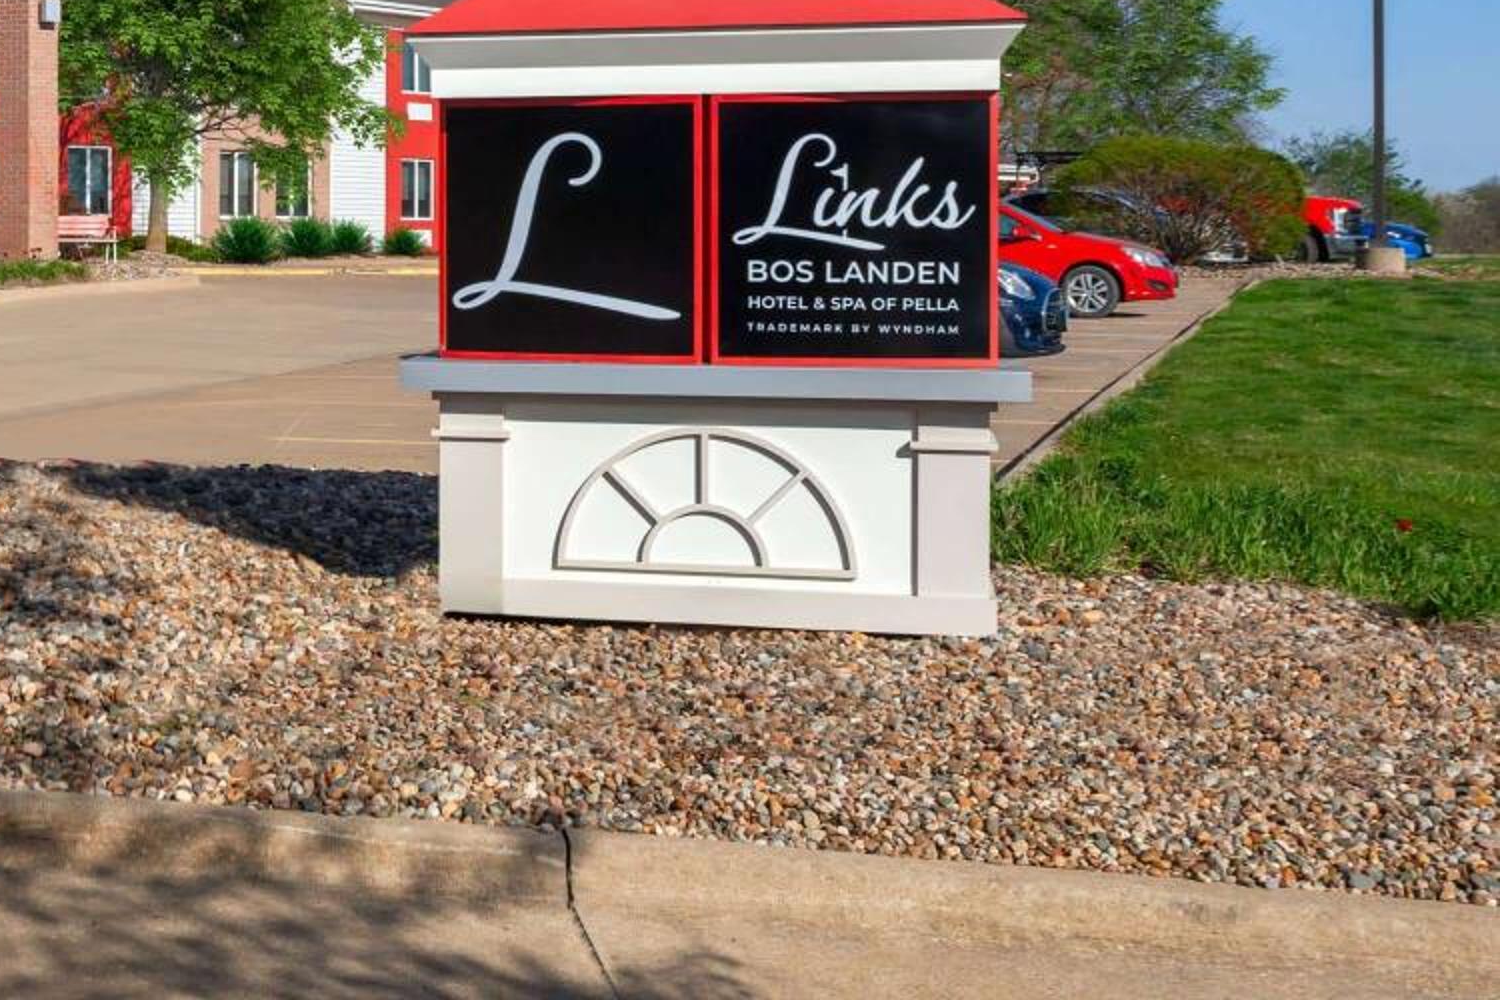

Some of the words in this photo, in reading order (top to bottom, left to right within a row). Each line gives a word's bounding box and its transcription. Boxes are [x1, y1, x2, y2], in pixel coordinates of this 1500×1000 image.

[732, 133, 977, 250] Links
[452, 133, 682, 321] L
[747, 260, 815, 283] BOS
[825, 260, 960, 285] LANDEN
[747, 295, 809, 310] HOTEL
[813, 296, 826, 311] &
[830, 297, 867, 311] SPA
[871, 297, 897, 311] OF
[902, 298, 960, 312] PELLA
[747, 322, 843, 333] TRADEMARK
[851, 323, 870, 334] BY
[877, 324, 959, 335] WYNDHAM
